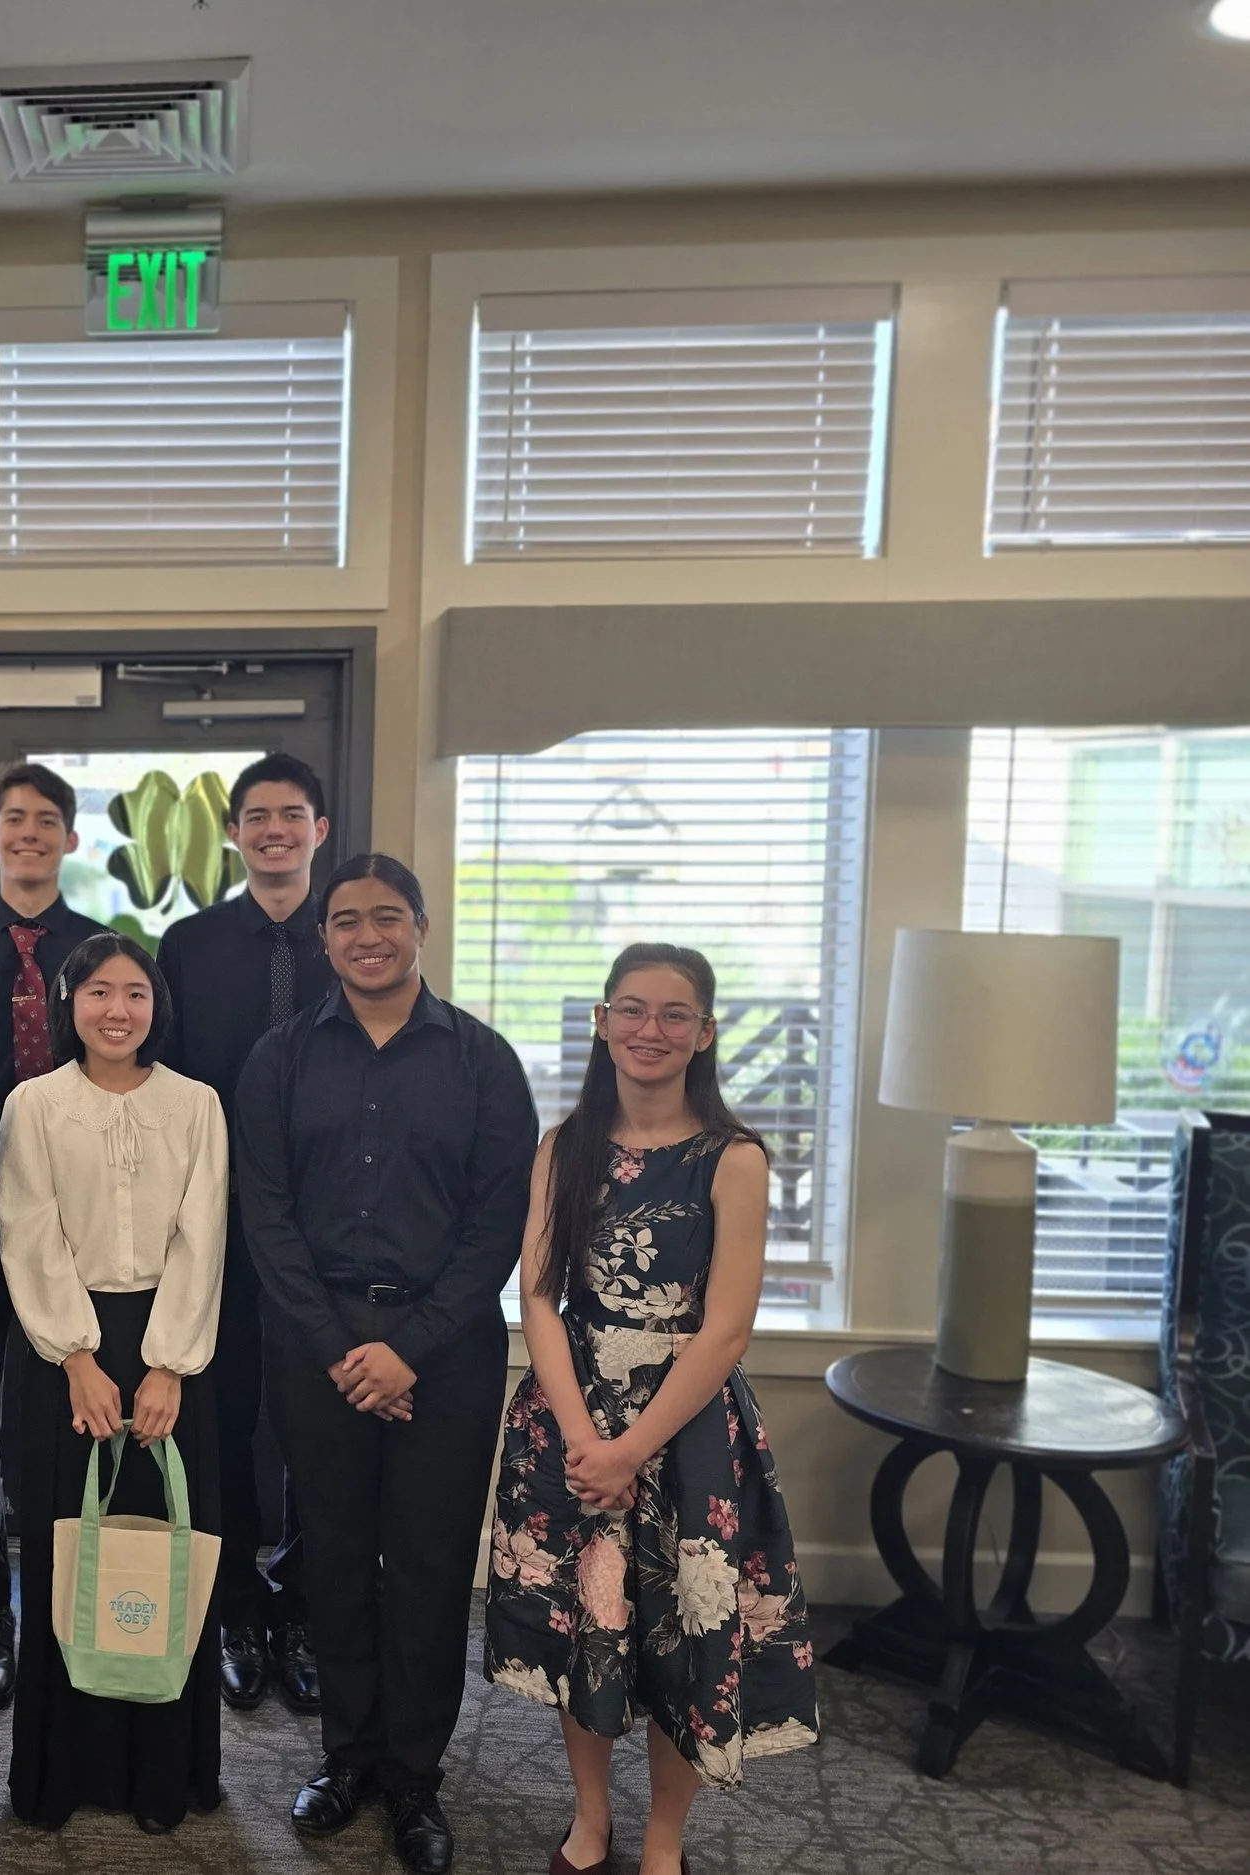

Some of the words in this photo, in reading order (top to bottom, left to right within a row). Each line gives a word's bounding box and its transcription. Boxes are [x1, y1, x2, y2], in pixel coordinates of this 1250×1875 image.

[107, 251, 206, 330] EXIT
[109, 1600, 158, 1614] TRADER
[114, 1612, 151, 1626] JOE'S
